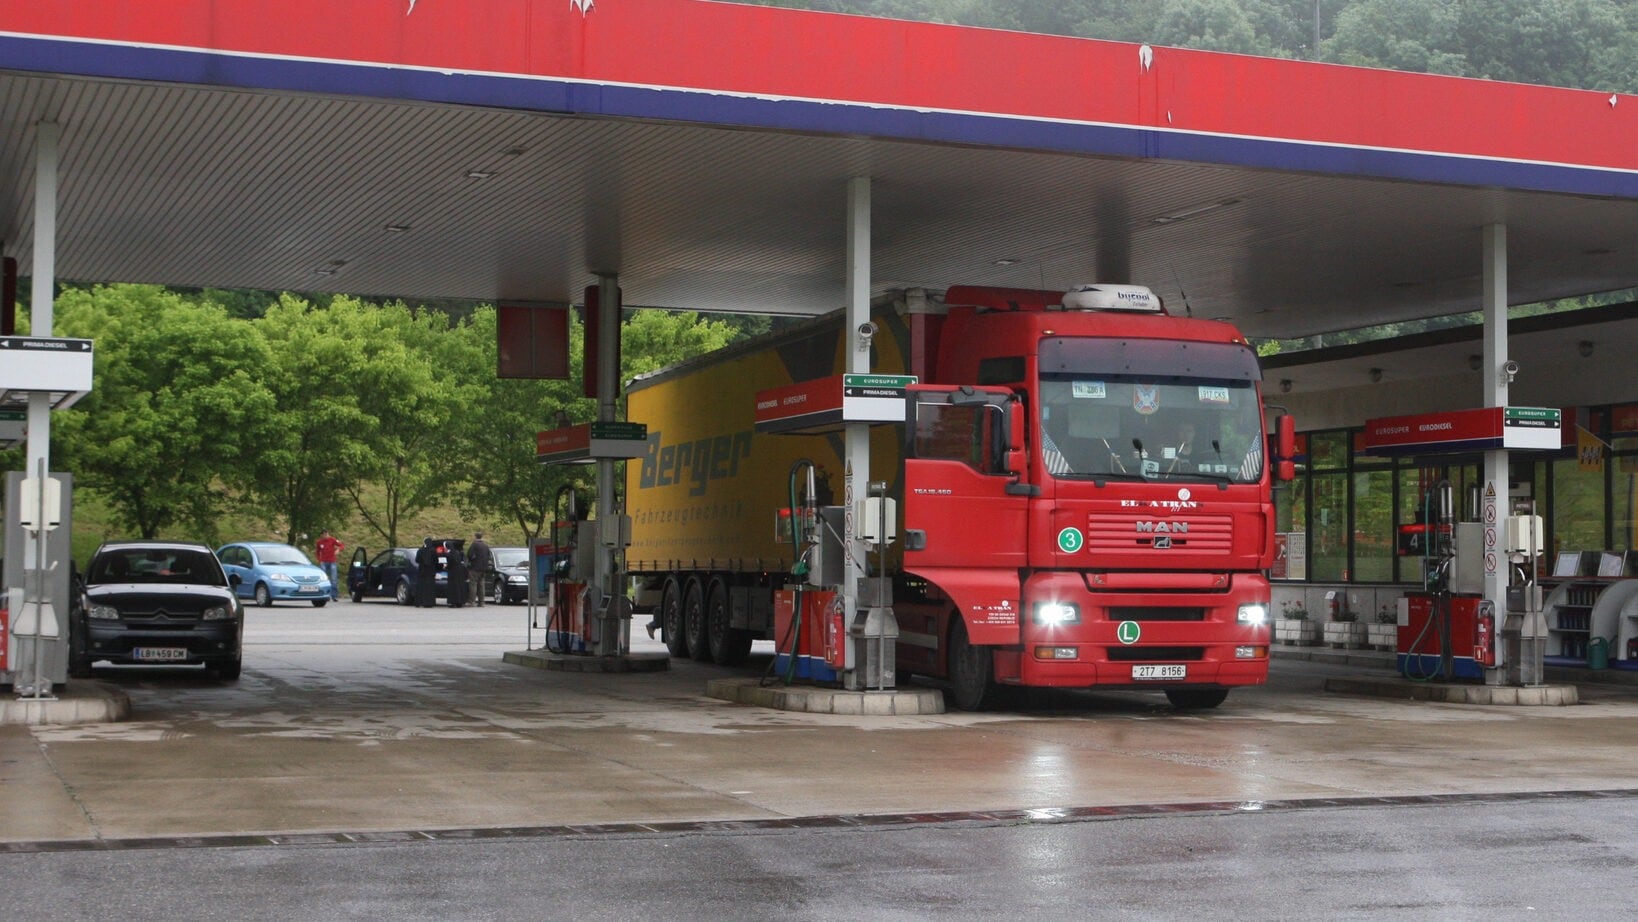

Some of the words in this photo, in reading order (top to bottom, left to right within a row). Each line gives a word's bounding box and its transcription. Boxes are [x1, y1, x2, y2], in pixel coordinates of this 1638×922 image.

[1117, 291, 1150, 302] bycool
[1375, 426, 1410, 435] EUROSUPER
[1419, 422, 1453, 432] EURODIESEL
[640, 431, 752, 497] Berger
[1136, 521, 1188, 533] MAN
[1065, 532, 1076, 548] 3
[1410, 533, 1419, 549] 4
[1123, 623, 1134, 640] L
[1140, 667, 1155, 677] 2T7
[1161, 666, 1182, 676] 8156
